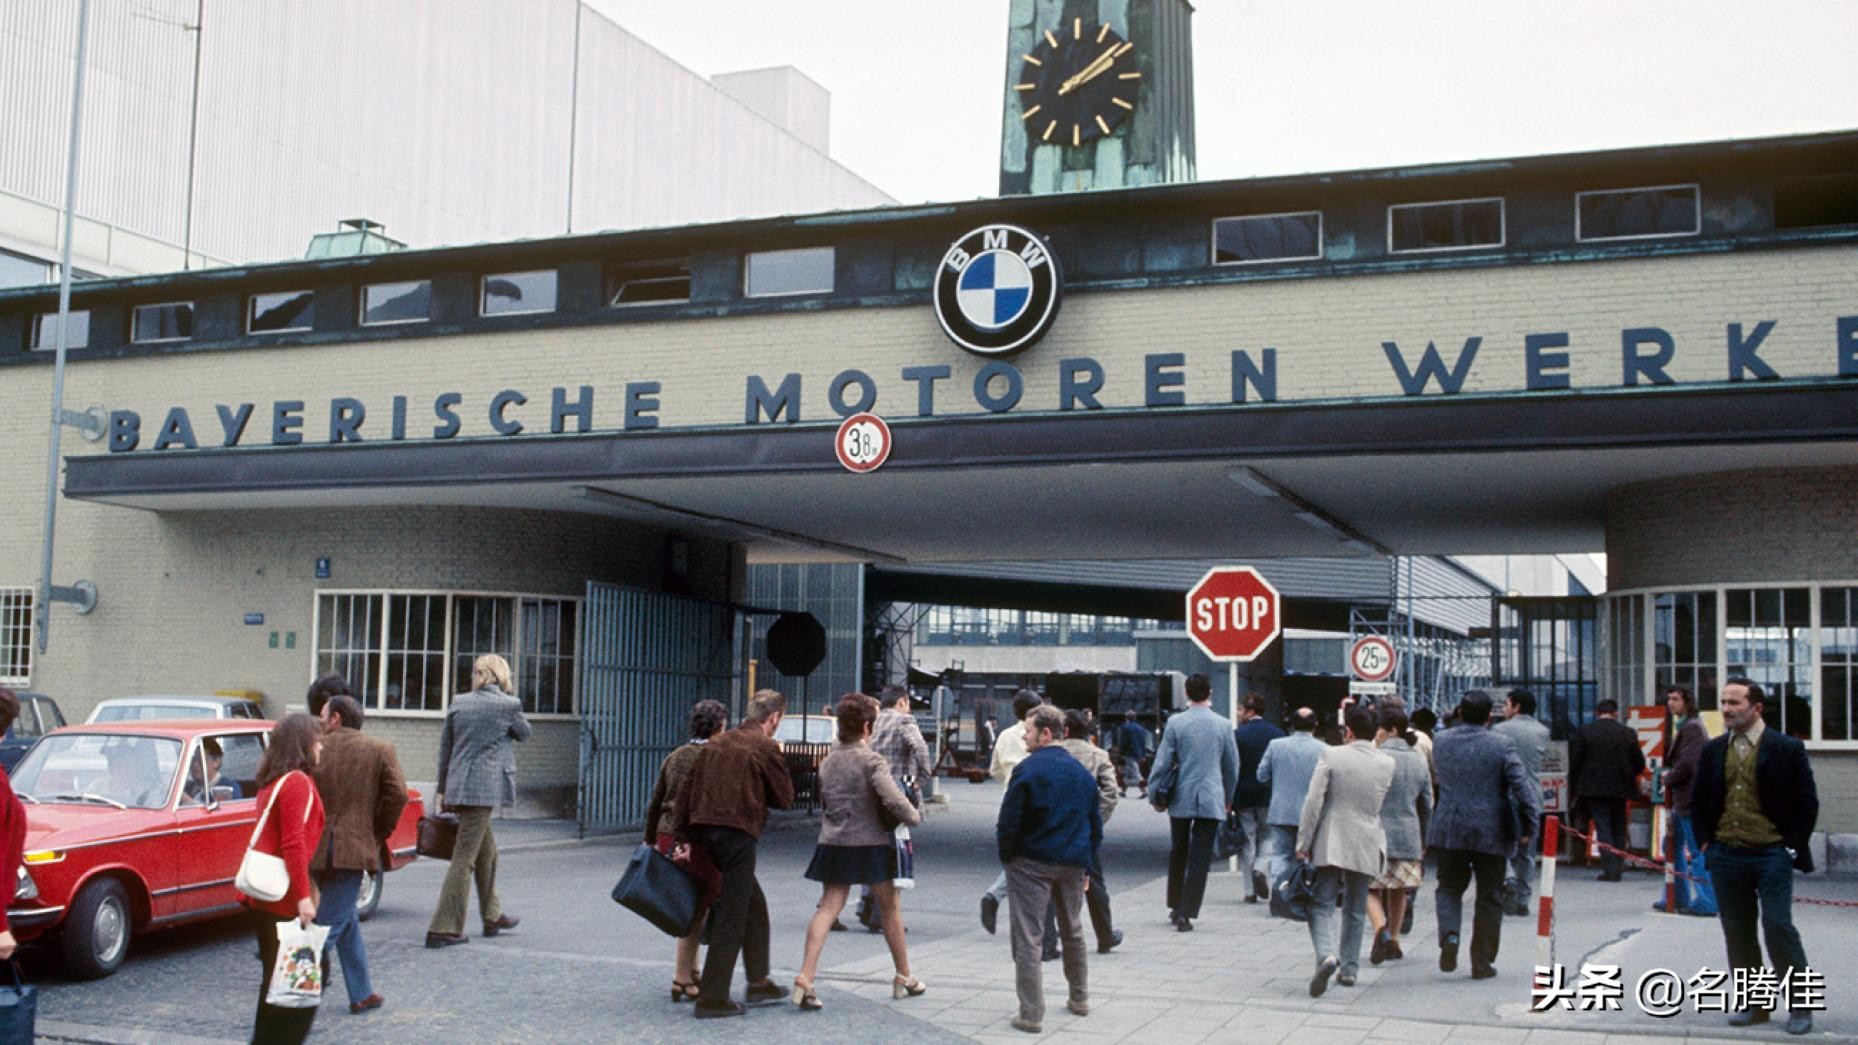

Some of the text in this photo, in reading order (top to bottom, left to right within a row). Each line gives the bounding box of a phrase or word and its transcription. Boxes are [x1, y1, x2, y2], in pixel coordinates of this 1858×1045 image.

[946, 229, 1046, 273] BMW
[108, 381, 661, 453] BAYERISCHE
[745, 347, 1277, 422] MOTOREN
[1197, 595, 1269, 632] STOP
